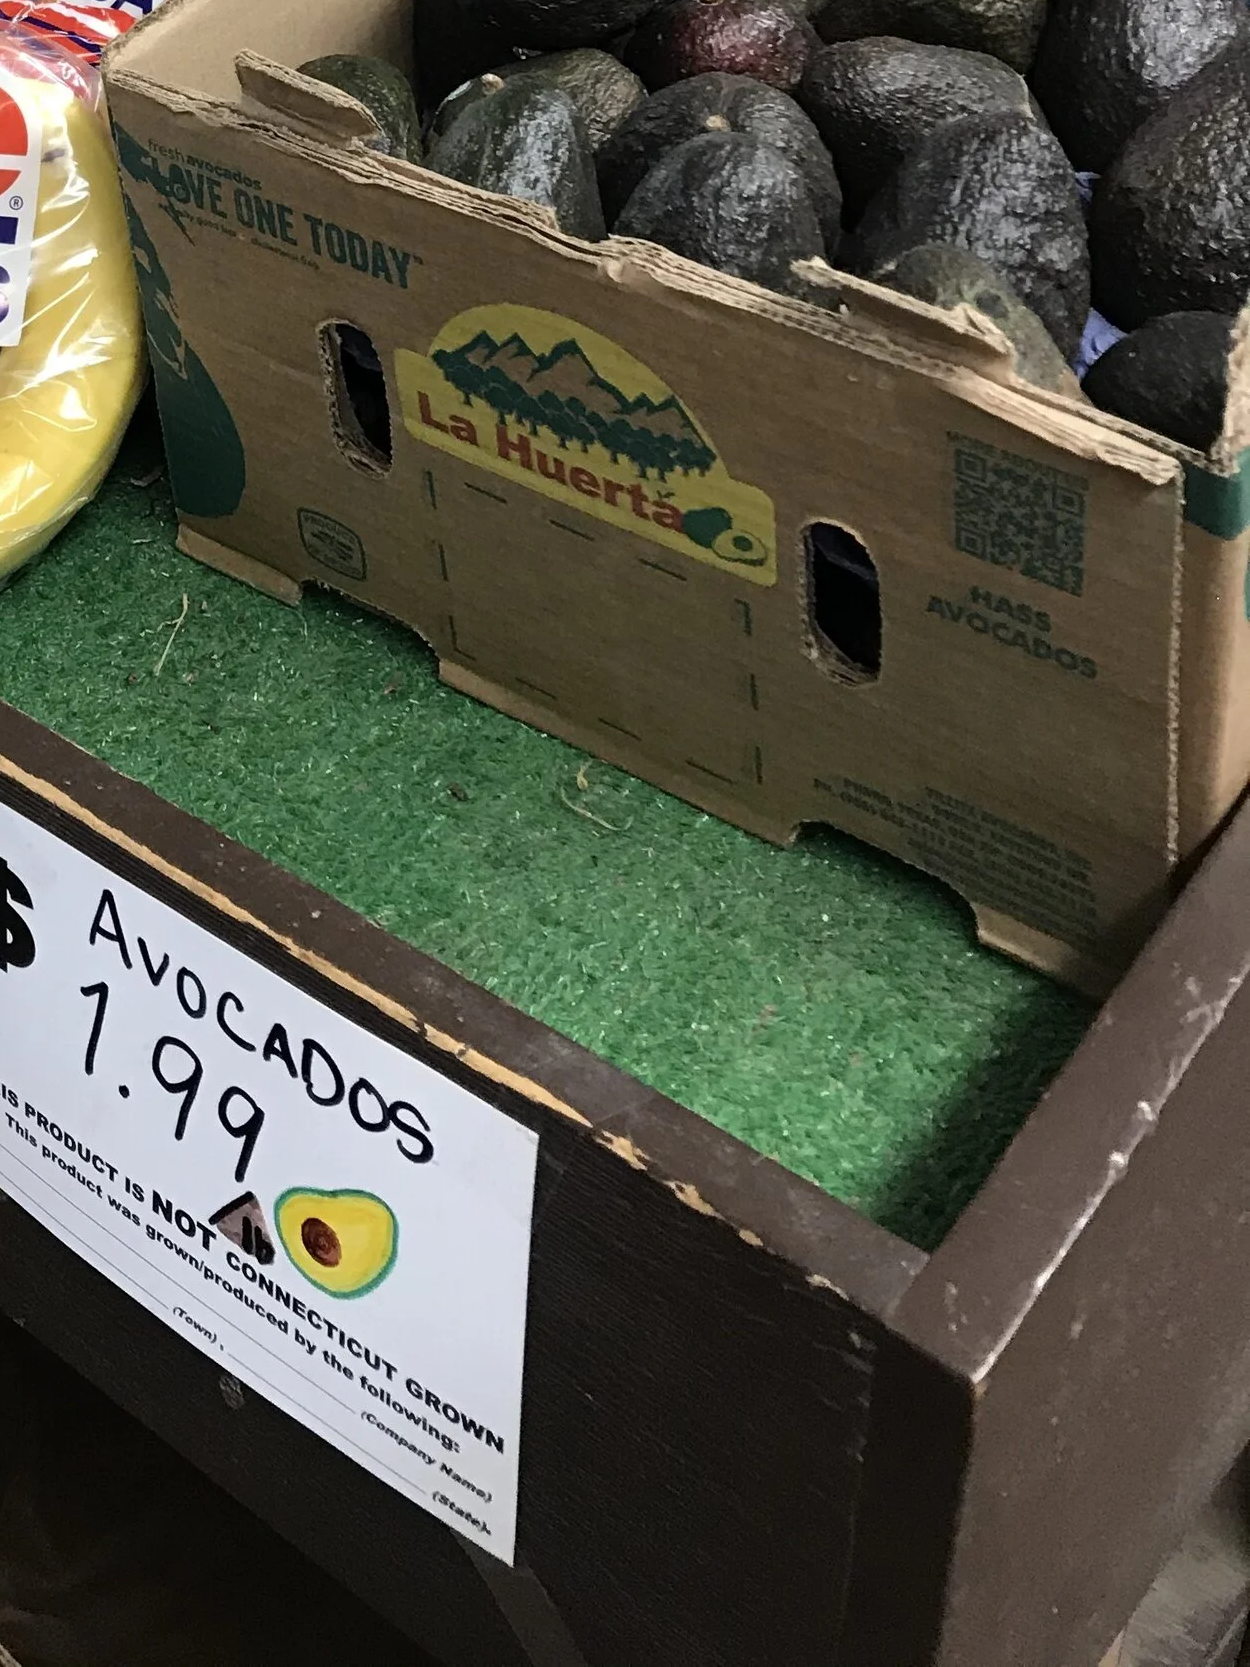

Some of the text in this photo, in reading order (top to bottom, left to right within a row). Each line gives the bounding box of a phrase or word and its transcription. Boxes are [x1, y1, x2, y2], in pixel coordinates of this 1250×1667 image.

[187, 154, 263, 191] avocados
[234, 187, 298, 246] ONE
[417, 390, 686, 535] La Huerta
[925, 594, 1098, 679] AVOCADOS
[969, 585, 1052, 633] HASS
[80, 980, 265, 1183] 1.99
[89, 888, 435, 1164] AVOCADOS
[5, 1111, 461, 1454] This product was grown/produced by the following:
[24, 1101, 118, 1183] PRODUCT
[125, 1175, 145, 1204] IS
[152, 1189, 218, 1252] NOT
[226, 1251, 398, 1383] CONNECTICUT
[405, 1376, 505, 1455] GROWN
